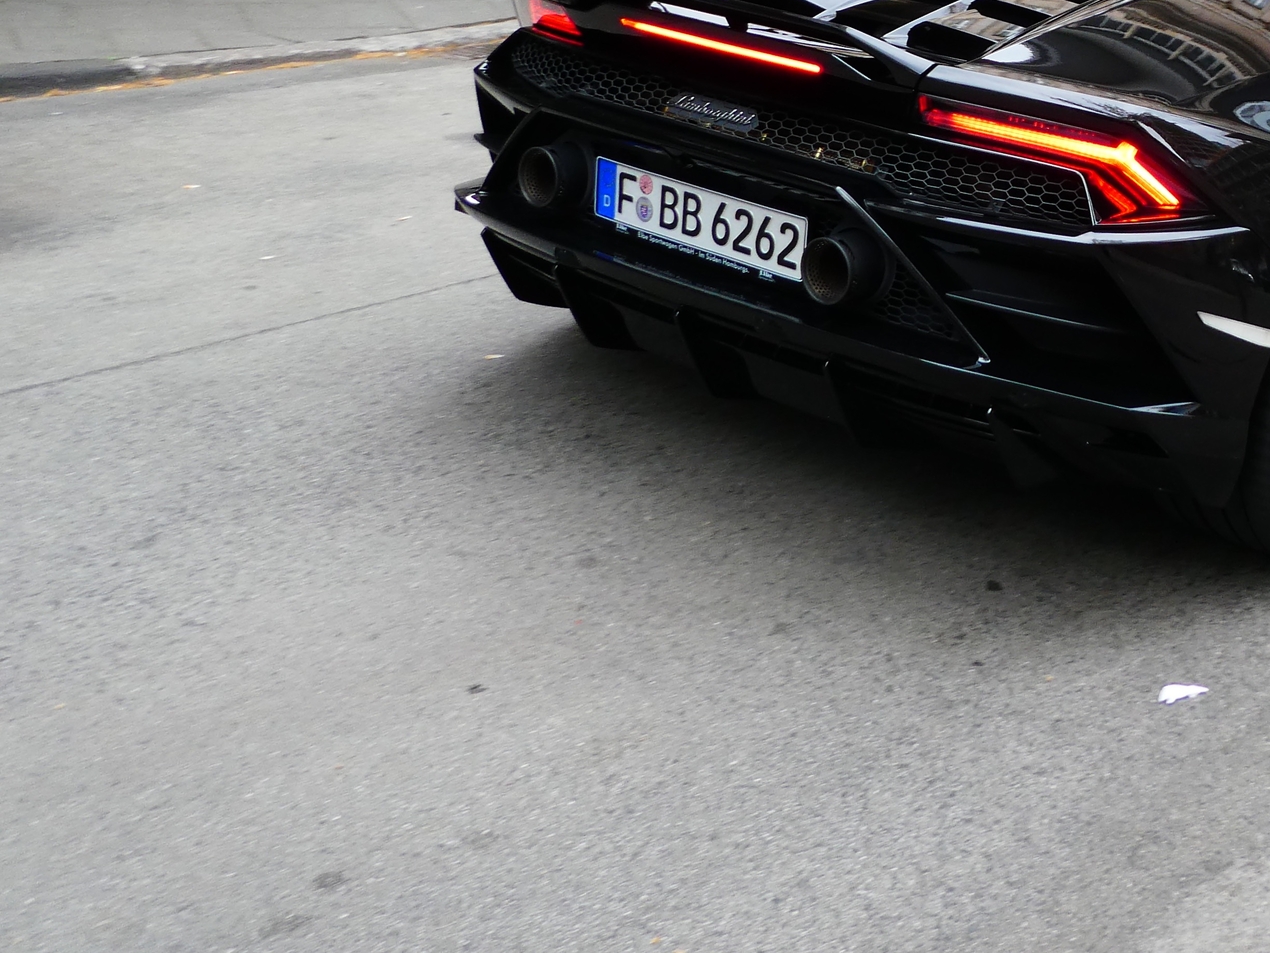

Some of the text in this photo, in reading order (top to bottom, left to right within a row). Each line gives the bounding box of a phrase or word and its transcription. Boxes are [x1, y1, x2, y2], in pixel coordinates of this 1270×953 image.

[667, 95, 756, 125] Lamborghini
[603, 194, 611, 207] D
[617, 171, 800, 270] F BB 6262
[649, 234, 678, 250] Sportwagen
[678, 244, 695, 255] GmbH
